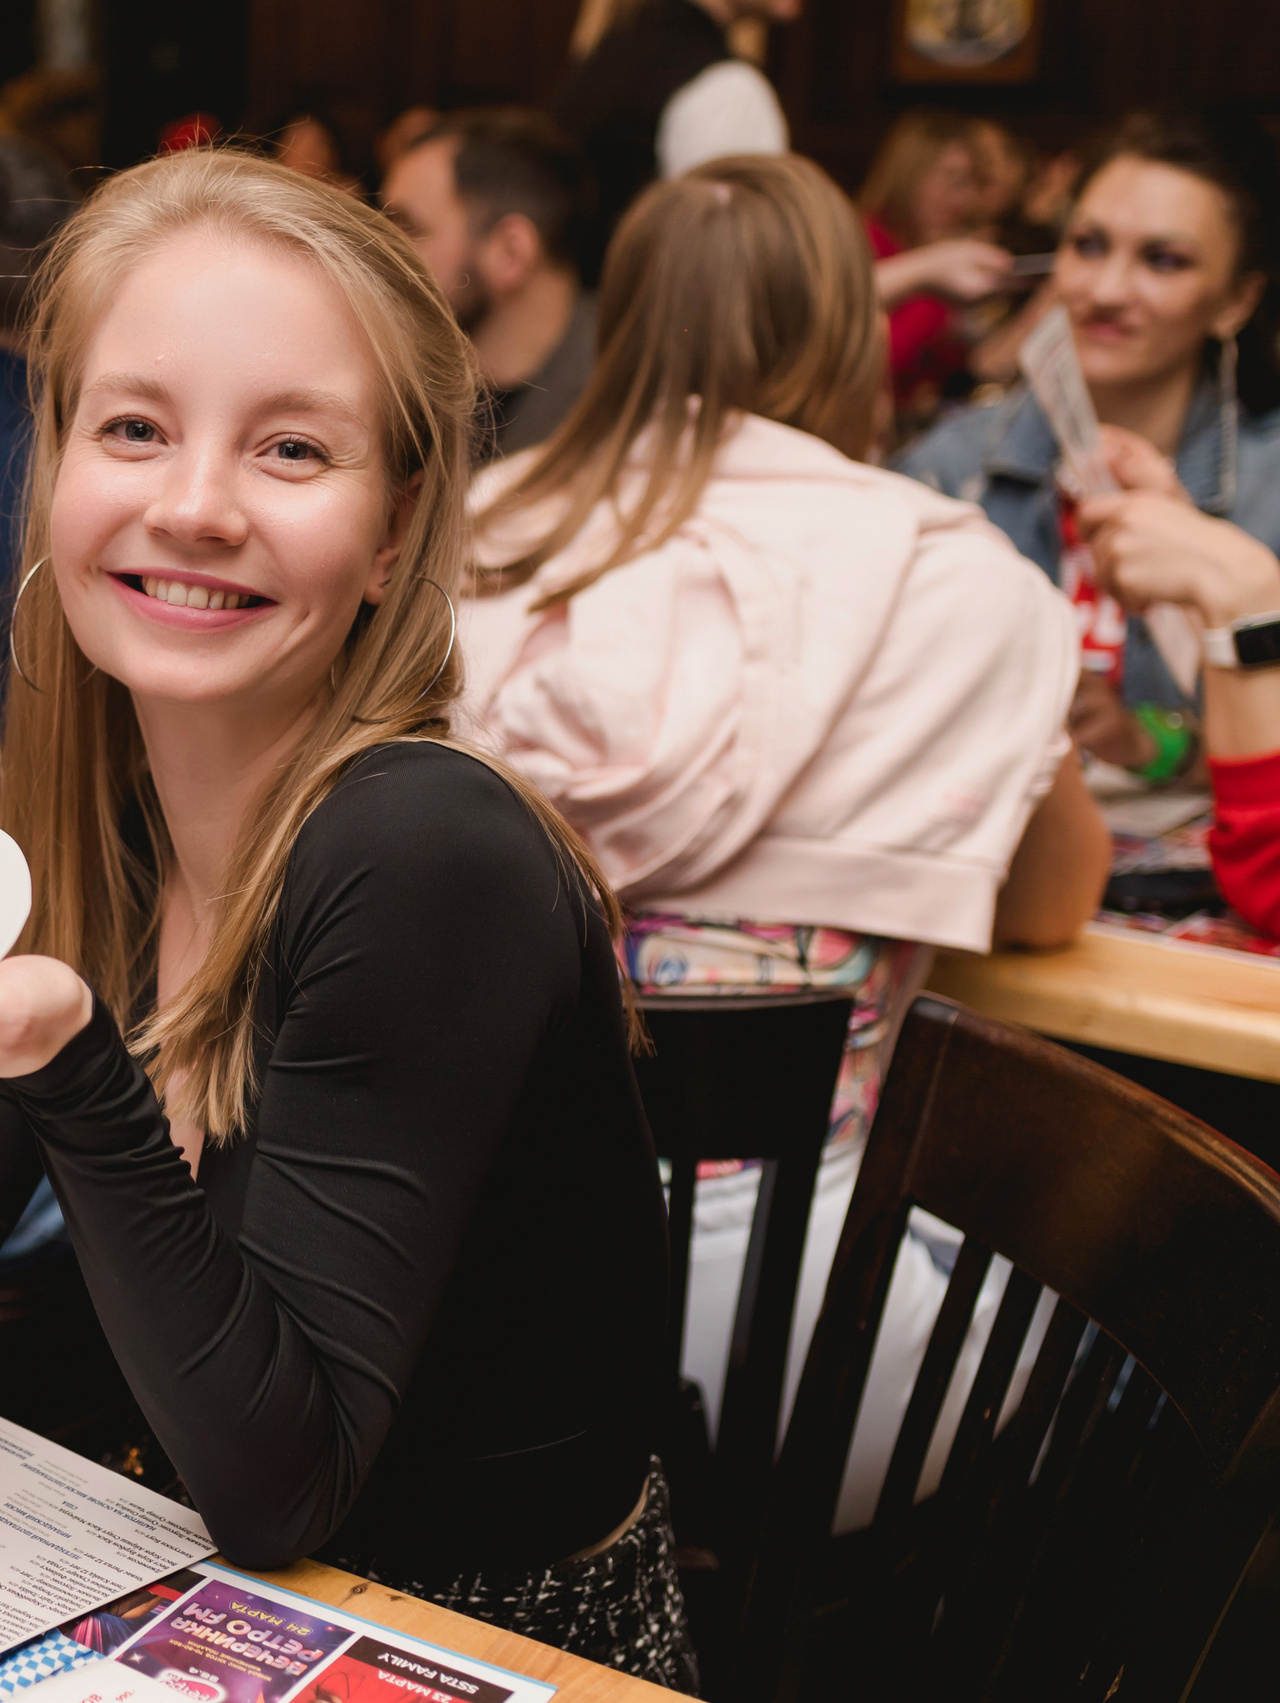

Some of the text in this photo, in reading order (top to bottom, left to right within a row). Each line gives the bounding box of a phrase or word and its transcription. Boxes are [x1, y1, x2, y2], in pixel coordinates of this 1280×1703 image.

[182, 1602, 324, 1662] РЕТРО FM
[230, 1601, 313, 1636] 24 МАРТА
[170, 1616, 308, 1676] ВЕЧЕРИНКА
[378, 1653, 479, 1694] 5STA FAMILY
[378, 1670, 453, 1703] 23 МАРТА
